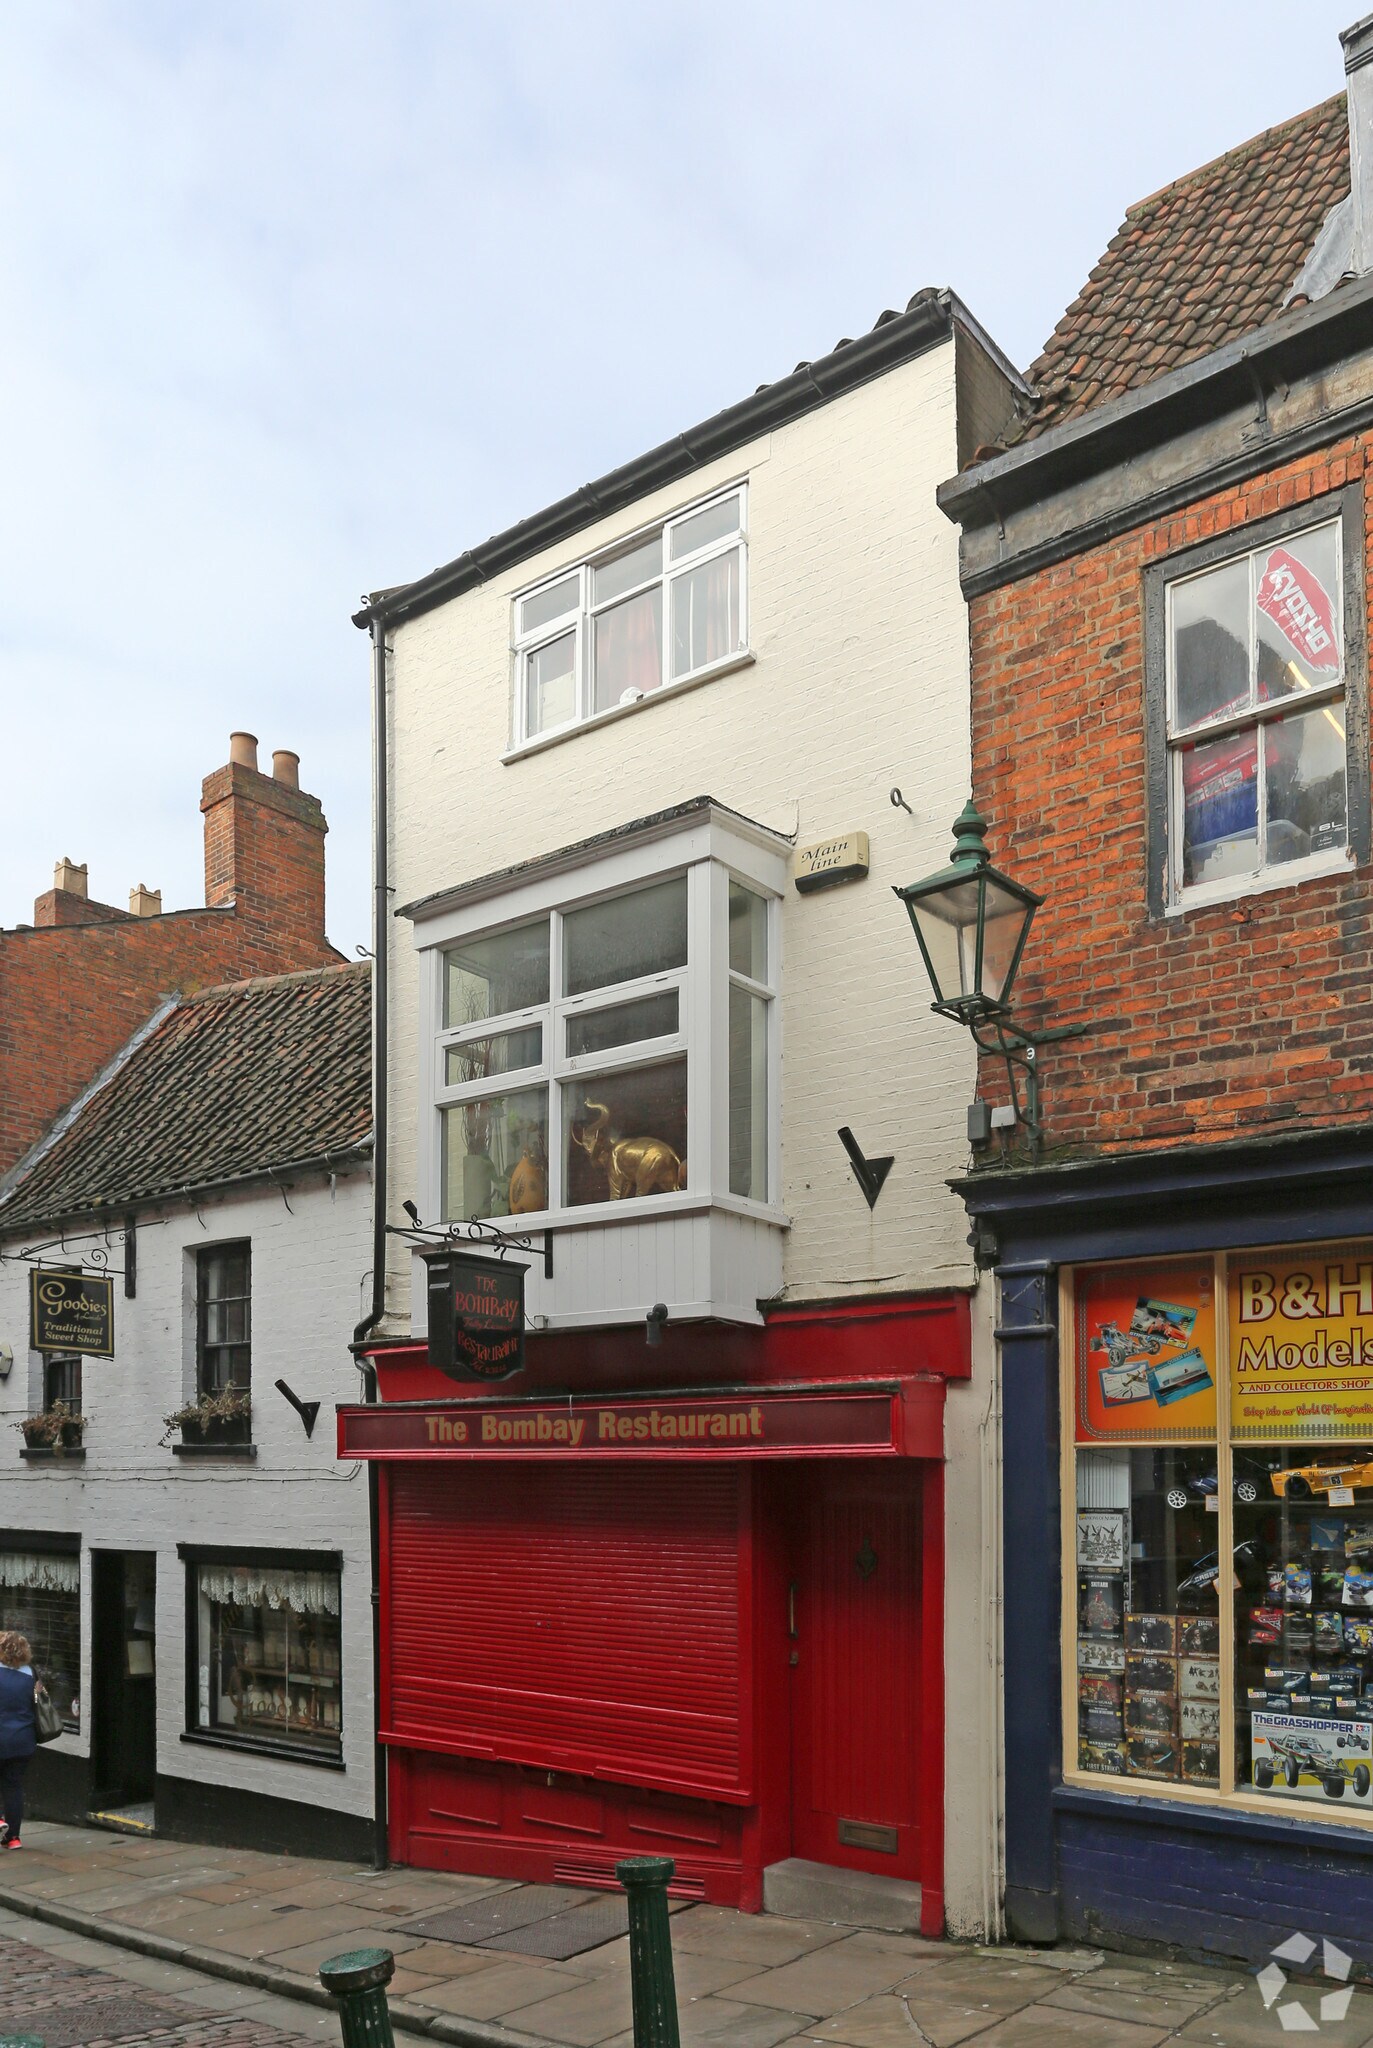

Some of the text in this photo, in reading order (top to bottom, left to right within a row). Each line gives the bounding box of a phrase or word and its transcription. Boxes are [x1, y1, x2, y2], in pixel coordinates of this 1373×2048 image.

[1273, 563, 1331, 655] KYOSHO
[801, 841, 848, 863] Main
[810, 855, 841, 871] line
[39, 1281, 107, 1316] Goodies
[1239, 1262, 1373, 1323] B&H
[44, 1321, 103, 1335] Traditional
[45, 1331, 102, 1346] Sweet Shop
[1249, 1379, 1370, 1392] AND COLLECTORS SHOP
[425, 1407, 764, 1447] The Bombay Restaurant
[1254, 1714, 1273, 1724] The
[1273, 1717, 1354, 1733] GRASSHOPPER
